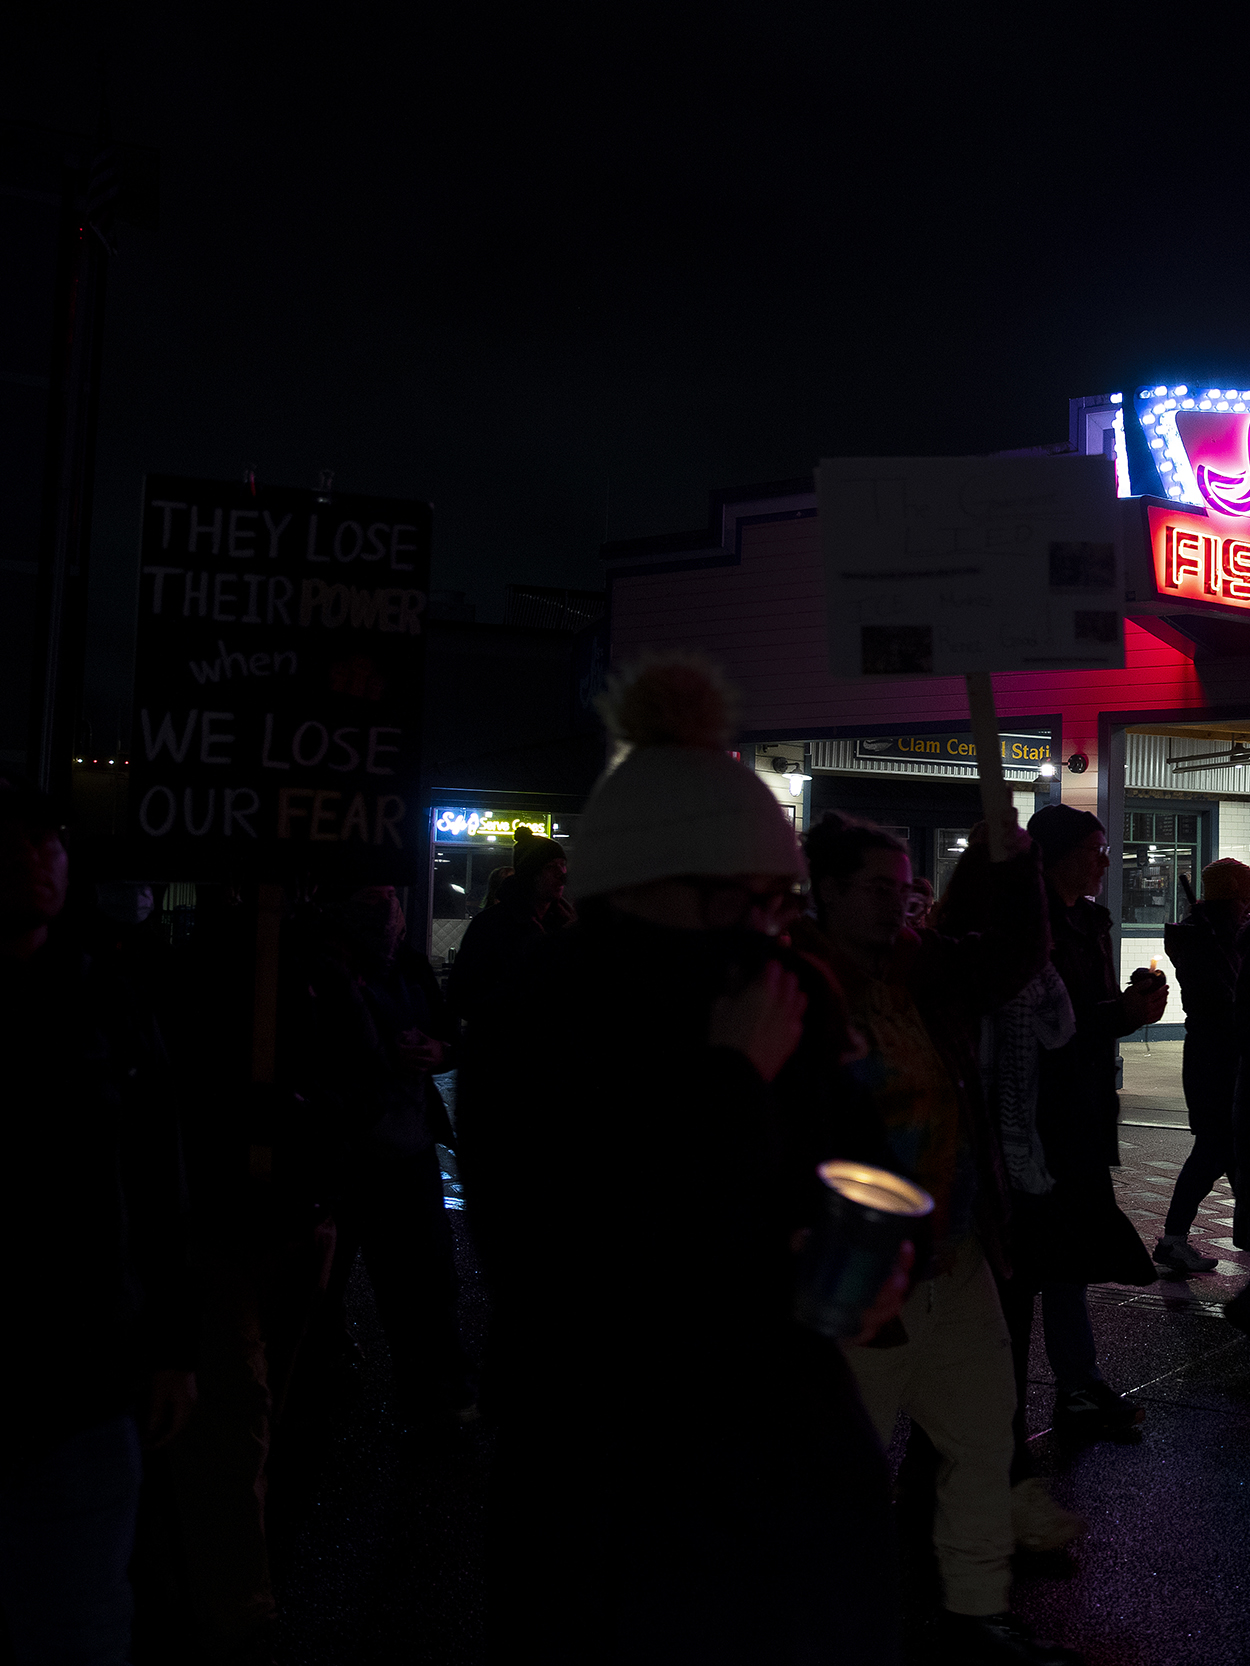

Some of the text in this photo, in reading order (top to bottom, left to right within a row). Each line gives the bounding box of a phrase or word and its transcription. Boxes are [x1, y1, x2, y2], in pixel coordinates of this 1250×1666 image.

[150, 500, 418, 572] THEY LOSE
[142, 565, 427, 635] THEIR POWER
[189, 639, 298, 685] when
[140, 707, 402, 776] WE LOSE
[898, 738, 940, 753] Clam
[947, 739, 1005, 757] Cenl
[139, 784, 406, 849] OUR FEAR
[479, 817, 509, 831] Serve
